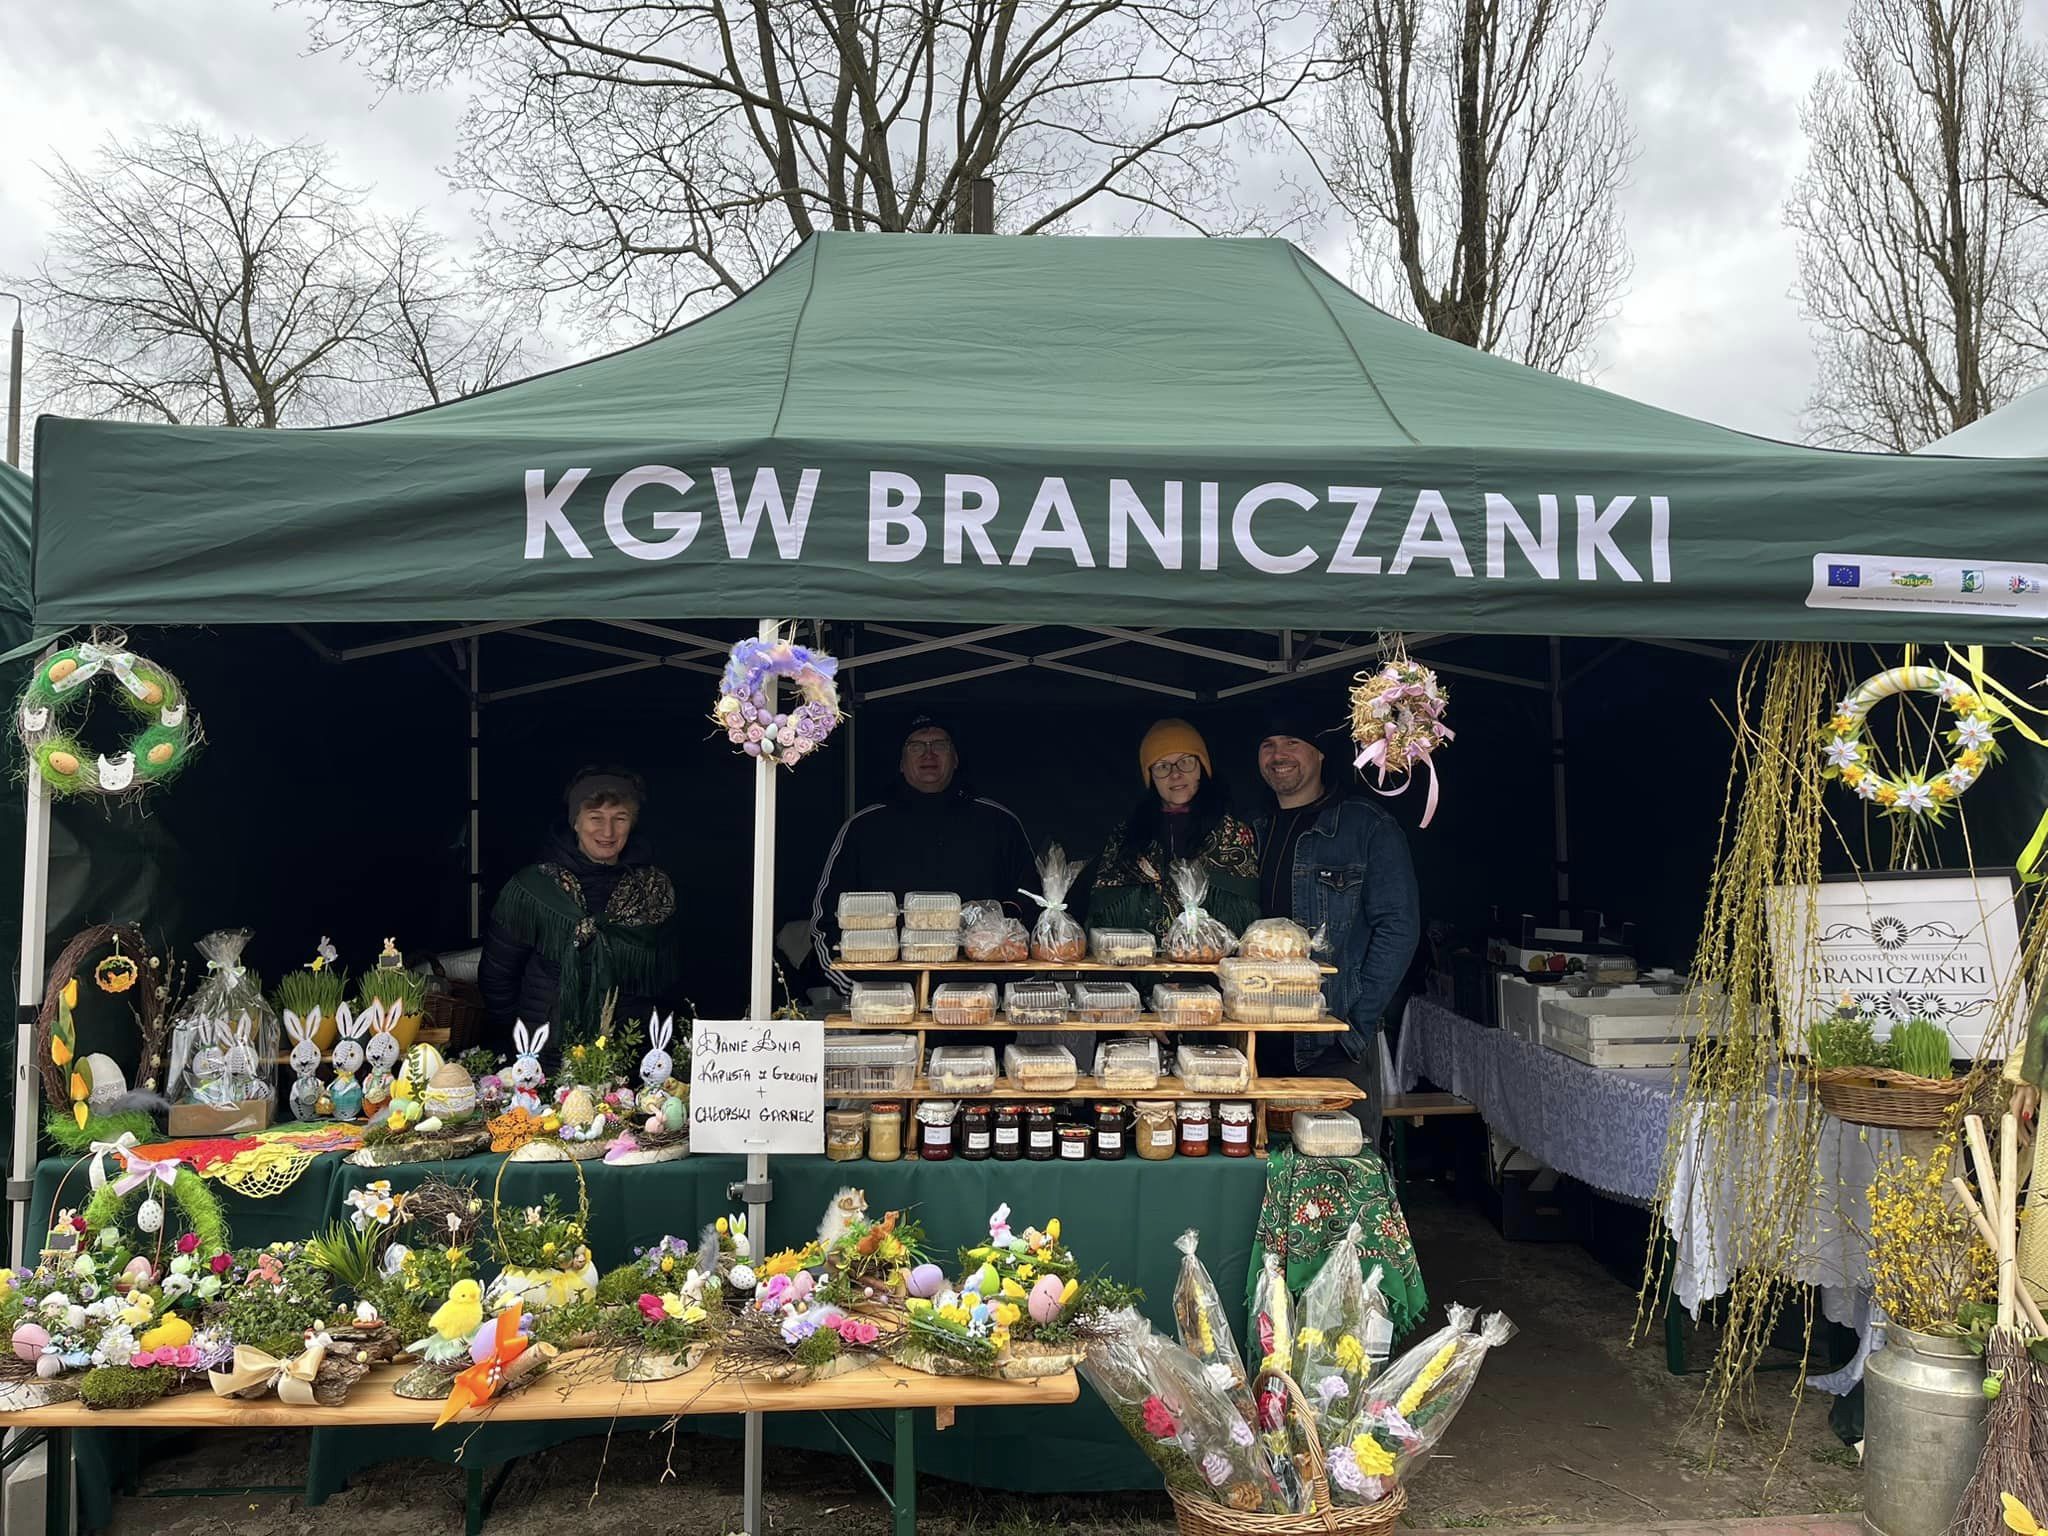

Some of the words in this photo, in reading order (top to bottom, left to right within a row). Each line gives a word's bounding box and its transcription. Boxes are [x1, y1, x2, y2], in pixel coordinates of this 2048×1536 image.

[523, 464, 822, 561] KGW
[867, 470, 1672, 583] BRANICZANKI
[1809, 966, 1988, 985] BRANICZANKI
[698, 1059, 751, 1083] KAPUSTA
[756, 1085, 767, 1099] +
[759, 1107, 815, 1123] GARNEK
